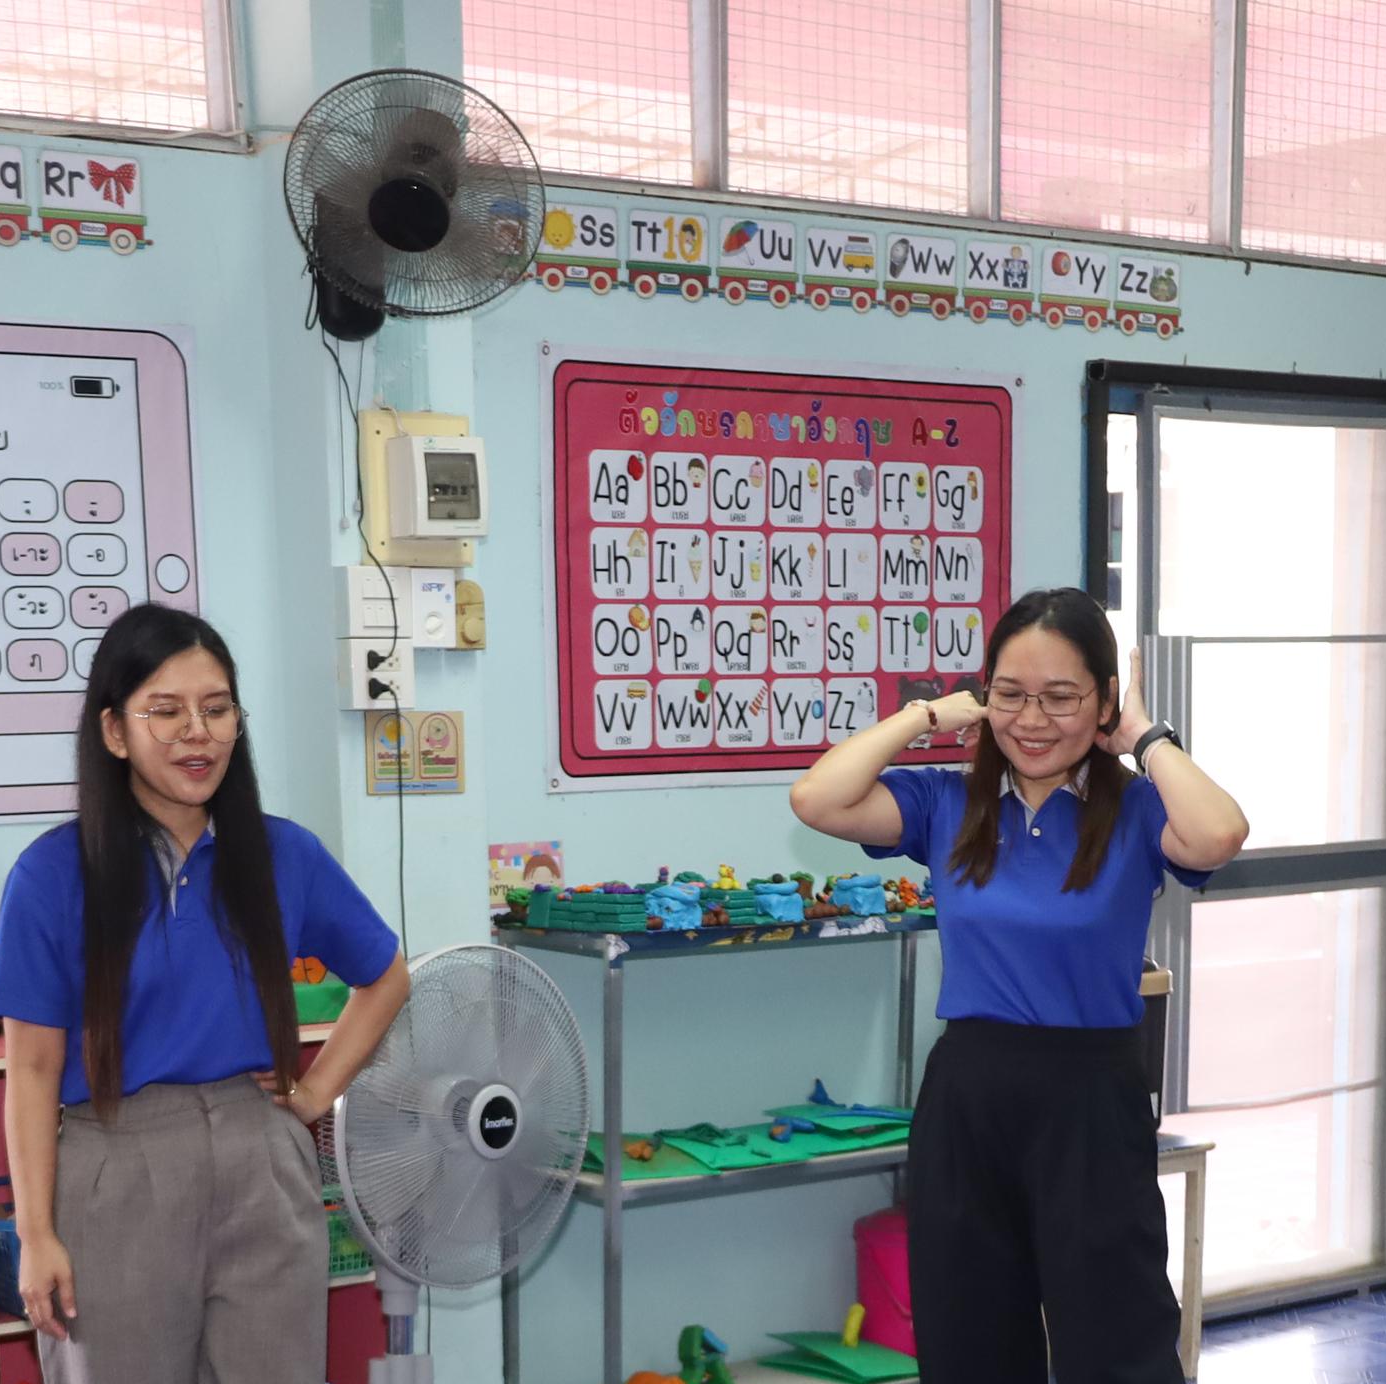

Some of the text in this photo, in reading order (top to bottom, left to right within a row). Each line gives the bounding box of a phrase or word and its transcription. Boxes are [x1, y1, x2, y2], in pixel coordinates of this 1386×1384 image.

[45, 161, 85, 198] Rr
[580, 214, 615, 247] Ss
[632, 221, 662, 252] Tt
[760, 229, 793, 261] Uu
[809, 238, 842, 269] Vv
[910, 245, 955, 276] Ww
[968, 250, 999, 281] Xx
[1075, 256, 1106, 294] Yy
[1120, 263, 1148, 294] Zz
[593, 462, 630, 506] Aa
[654, 461, 688, 508] Bb
[713, 468, 751, 511] Cc
[772, 467, 802, 512] Dd
[826, 474, 854, 517] Ee
[883, 472, 910, 513] Ff
[935, 470, 966, 521] Gg
[593, 539, 631, 585] Hh
[656, 540, 676, 583] Ii
[713, 536, 745, 589] Jj
[772, 544, 803, 588] Kk
[884, 549, 928, 586] Mm
[935, 545, 969, 582] Nn
[594, 617, 640, 657] Oo
[656, 617, 687, 672] Pp
[714, 620, 752, 672] Qq
[772, 619, 801, 658] Rr
[827, 622, 854, 661] Ss
[883, 615, 911, 656] Tt
[934, 619, 972, 657] Uu
[596, 692, 637, 734] Vv
[658, 694, 711, 731] Ww
[716, 691, 749, 731] Xx
[773, 690, 811, 740] Yy
[828, 690, 856, 730] Zz
